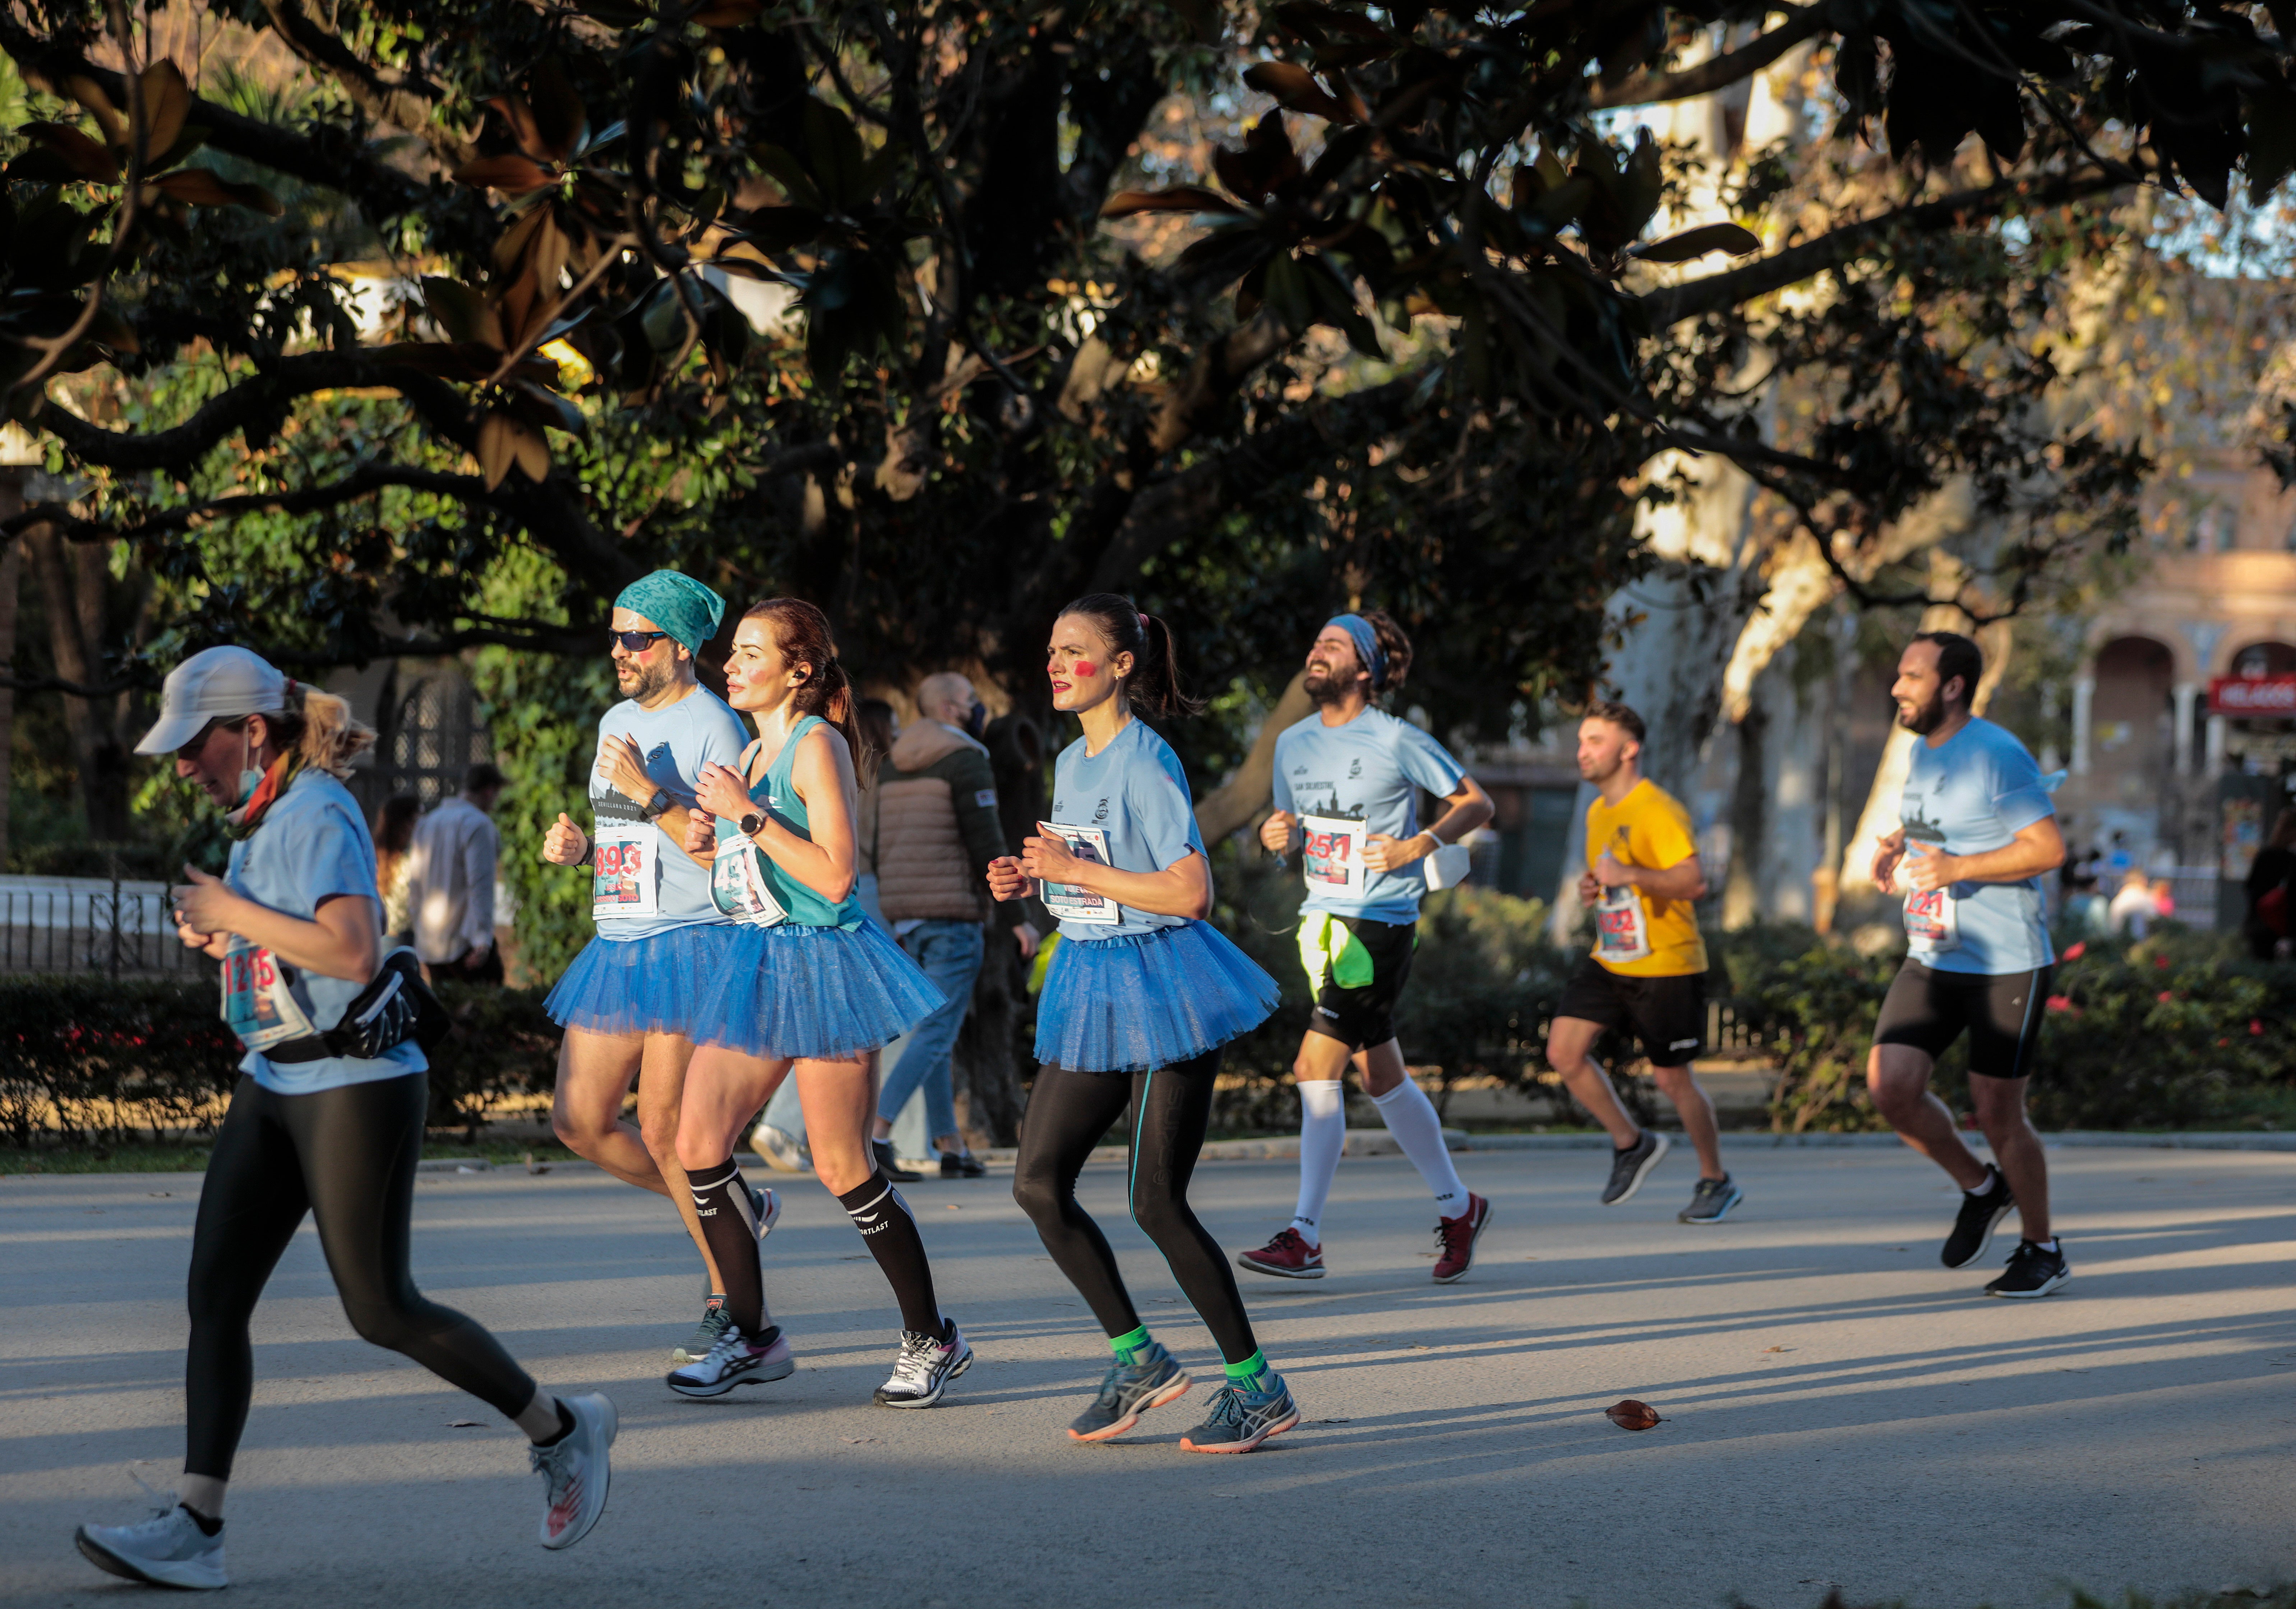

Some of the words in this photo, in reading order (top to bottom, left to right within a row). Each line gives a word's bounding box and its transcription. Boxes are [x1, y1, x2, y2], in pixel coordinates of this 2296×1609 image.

[598, 801, 622, 809] SEVILLANA
[1305, 830, 1350, 862] 251
[1049, 895, 1068, 904] SOTO
[1069, 897, 1103, 906] ESTRADA
